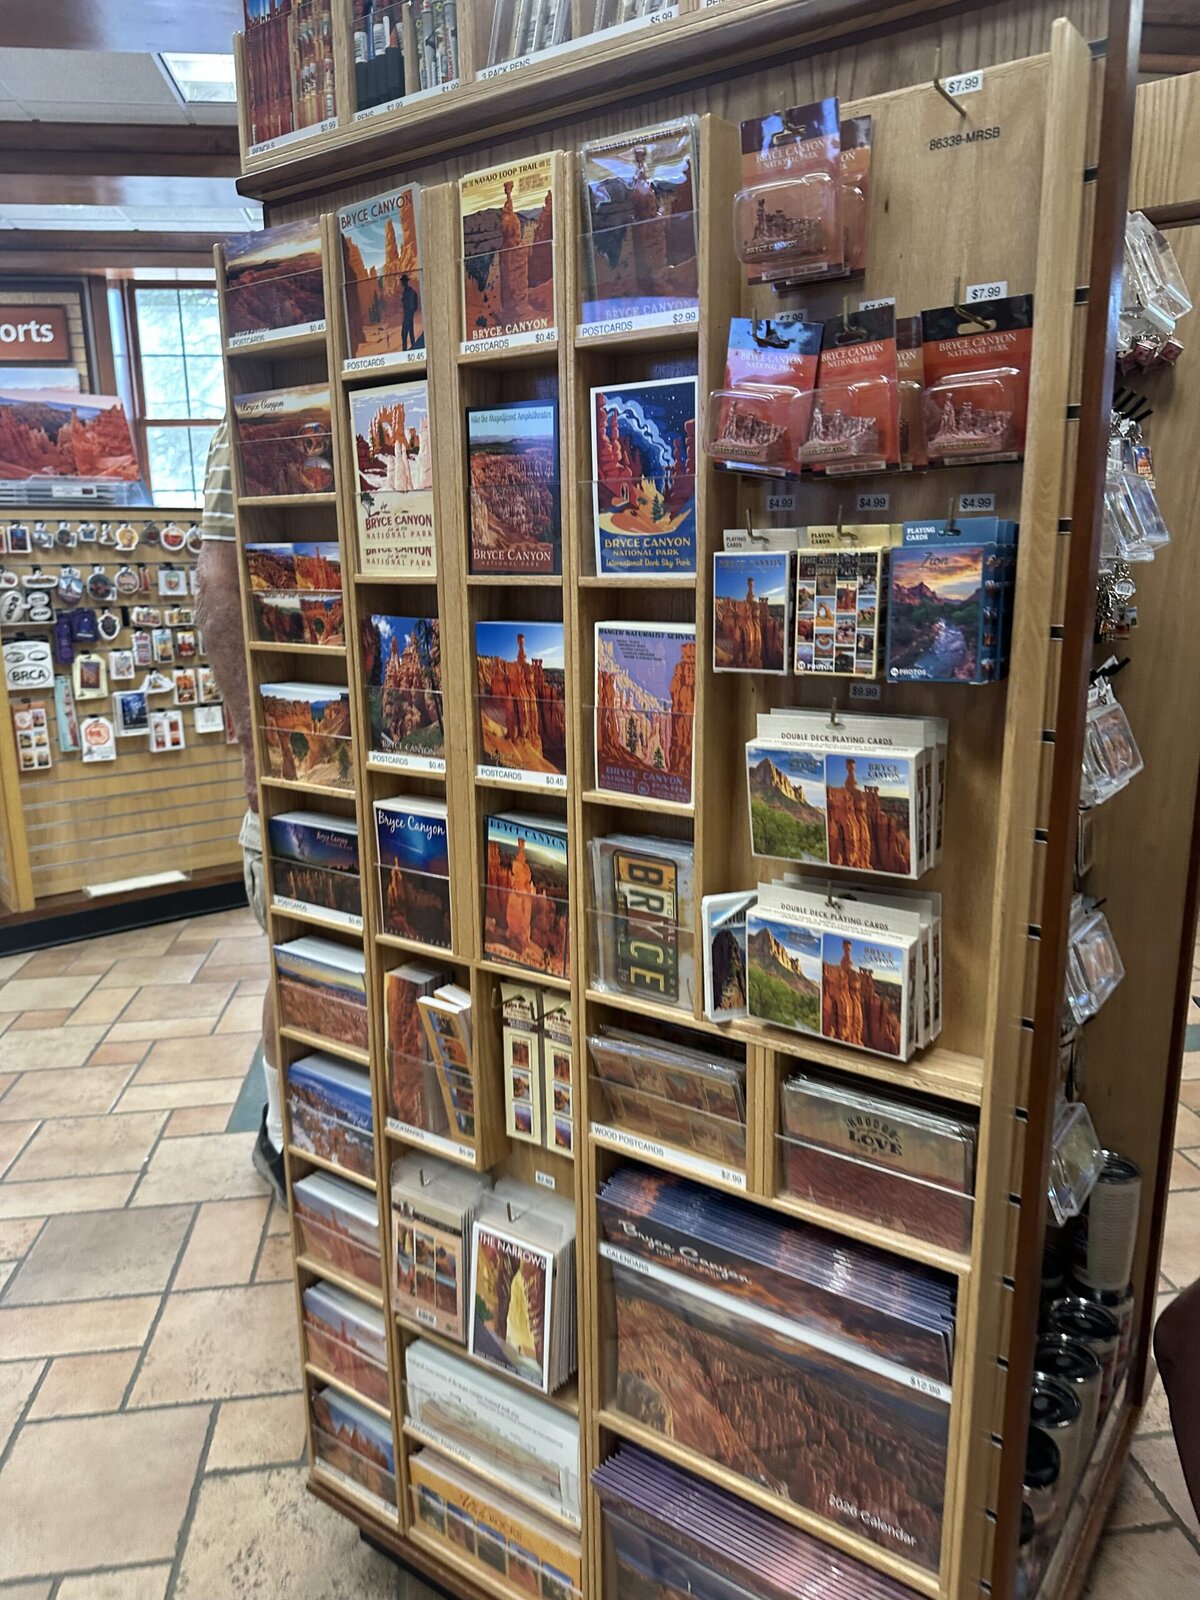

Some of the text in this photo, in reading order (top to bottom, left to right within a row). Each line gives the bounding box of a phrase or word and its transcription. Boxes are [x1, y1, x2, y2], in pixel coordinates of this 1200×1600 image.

[650, 11, 673, 24] $5.99
[488, 67, 508, 79] PACK
[509, 59, 531, 72] PENS
[948, 75, 979, 94] $7.99
[320, 121, 336, 133] $0.99
[928, 126, 1001, 151] 86339-MRSB
[474, 162, 538, 185] NAVAJO LOOP TRAIL
[341, 194, 412, 230] BRYCE CANYON
[971, 287, 1001, 300] $7.99
[472, 317, 548, 341] BRYCE CANYON
[582, 311, 696, 336] POSTCARDS $2.99
[232, 334, 265, 347] POSTCARDS
[464, 331, 555, 353] POSTCARDS $0.45
[939, 333, 1017, 352] BRYCE CANYON
[740, 351, 803, 366] BRYCE CANYON
[821, 349, 848, 362] BRYCE
[848, 343, 884, 357] CANYON
[947, 343, 1009, 358] NATIONAL PARK
[346, 351, 425, 370] POSTCARDS $0.45
[827, 354, 878, 369] NATIONAL PARK
[768, 498, 793, 509] $4.99
[858, 497, 887, 509] $4.99
[961, 497, 993, 510] $4.99
[365, 513, 433, 531] BRYCE CANYON
[906, 526, 936, 535] PLAYING
[366, 529, 433, 540] NATIONAL PARK
[605, 536, 691, 549] BRYCE CANYON
[410, 557, 432, 567] PARK
[473, 548, 551, 562] BRYCE CANYON
[606, 557, 692, 570] International Dark Sky Park
[919, 551, 949, 568] Zion
[625, 629, 665, 639] NATURALIST
[12, 669, 47, 681] BRCA
[899, 668, 927, 676] PHOTOS
[852, 686, 878, 698] $9.99
[780, 731, 893, 746] DOUBLE DECK PLAYING CARDS
[404, 741, 437, 756] CANYON
[372, 754, 446, 771] POSTCARDS $0.45
[868, 763, 898, 772] BRYCE
[481, 768, 564, 786] POSTCARDS $0.45
[642, 771, 683, 785] CANYON
[377, 809, 446, 840] Bryce Canyon
[490, 819, 566, 851] BRYCE CANYON
[780, 902, 890, 931] DOUBLE DECK PLAYING CARDS
[628, 863, 665, 992] BRYCE
[595, 1126, 618, 1141] WOOD
[619, 1135, 665, 1157] POSTCARDS
[848, 1129, 903, 1156] LOVE
[480, 1231, 547, 1271] THE NARROWS
[617, 1219, 753, 1287] Bryce Canyon
[606, 1248, 650, 1273] CALENDARS
[860, 1508, 918, 1547] Calendar
